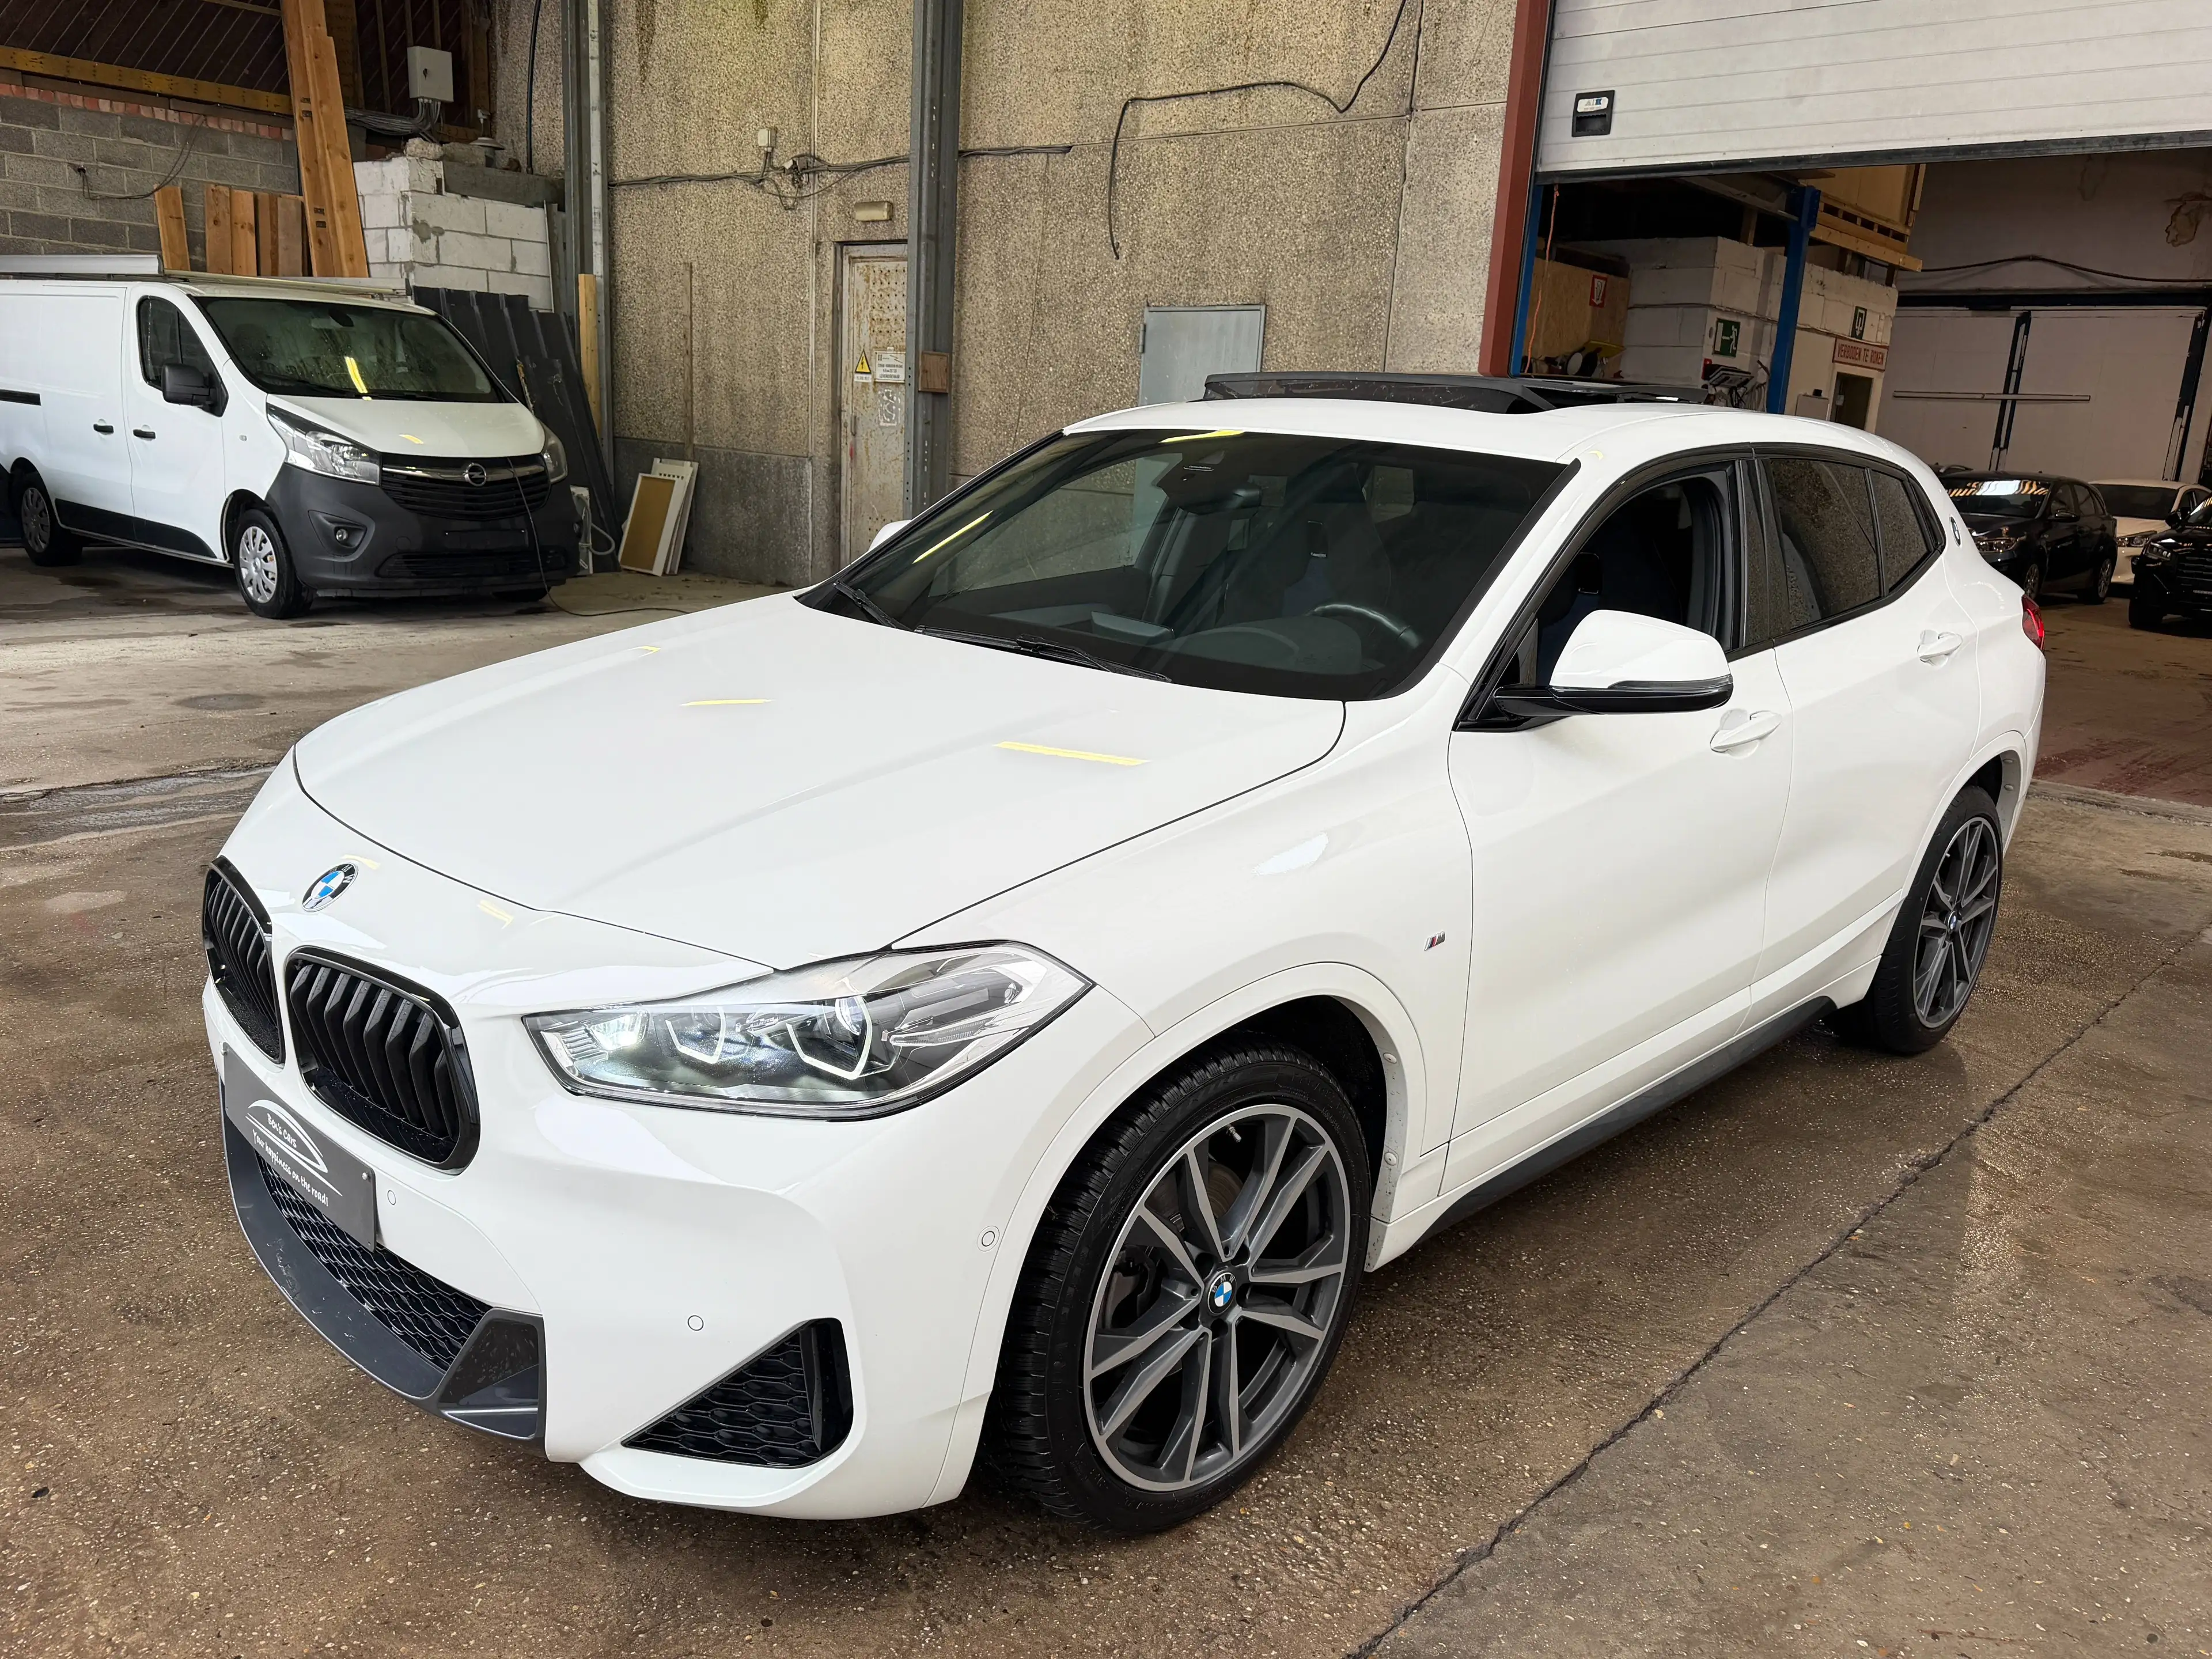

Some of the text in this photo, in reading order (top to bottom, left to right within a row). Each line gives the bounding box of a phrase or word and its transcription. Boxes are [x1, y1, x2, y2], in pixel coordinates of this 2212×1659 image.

[1862, 347, 1869, 362] TE
[283, 1128, 297, 1148] Cars
[252, 1128, 329, 1207] Your happiness on the road!
[1211, 1275, 1236, 1293] BMW
